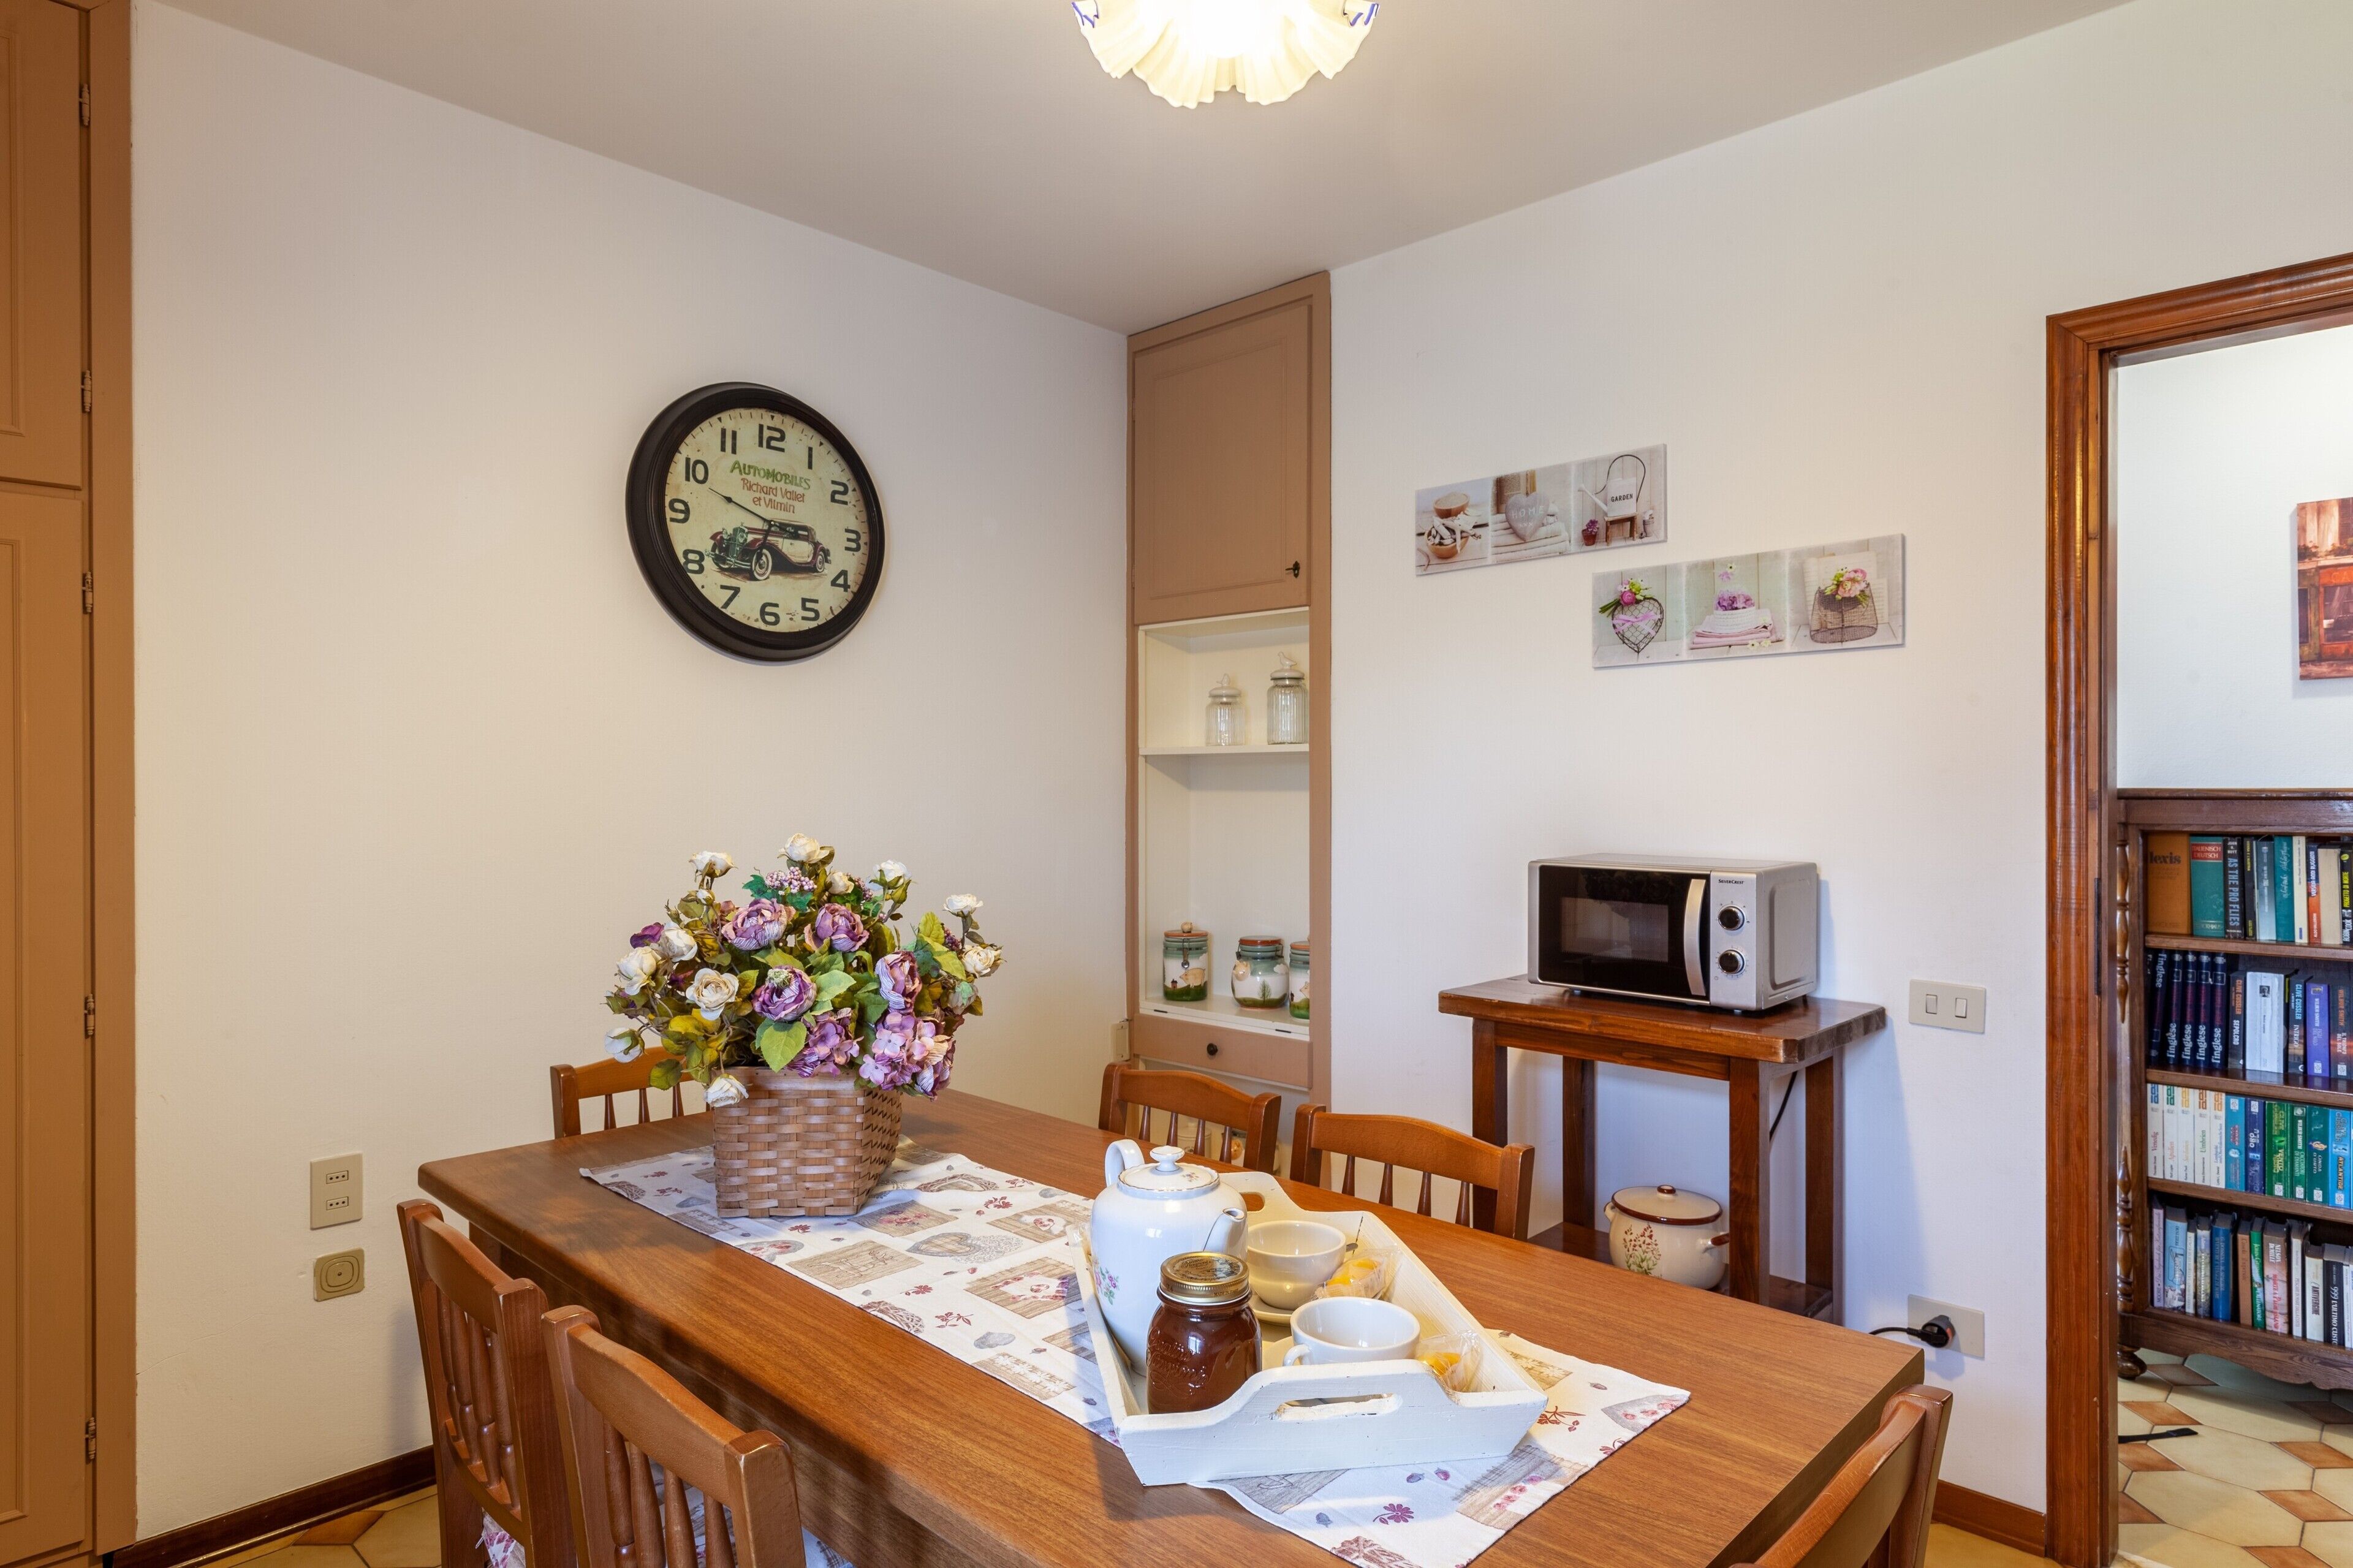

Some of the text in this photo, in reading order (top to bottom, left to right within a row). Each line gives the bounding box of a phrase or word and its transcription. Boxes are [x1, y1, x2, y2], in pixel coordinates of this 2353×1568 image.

[720, 428, 737, 454] 11
[758, 424, 785, 452] 12
[807, 447, 813, 469] 1
[685, 456, 709, 484] 10
[730, 460, 811, 490] AUTOMOBILES
[741, 478, 805, 502] Richard Vallet
[752, 496, 761, 506] et
[830, 480, 849, 505] 2
[1611, 493, 1633, 503] GARDEN
[668, 499, 691, 523] 9
[1512, 506, 1544, 519] HOME
[845, 529, 861, 551] 3
[683, 549, 705, 574] 8
[830, 569, 851, 592] 4
[719, 584, 740, 610] 7
[759, 602, 780, 626] 6
[801, 597, 820, 621] 5
[2148, 852, 2181, 865] lexis
[2227, 858, 2238, 868] AS
[2228, 870, 2239, 885] THE
[2229, 887, 2239, 902] PRO
[2229, 904, 2240, 926] FLIES
[2330, 1286, 2339, 1300] 999
